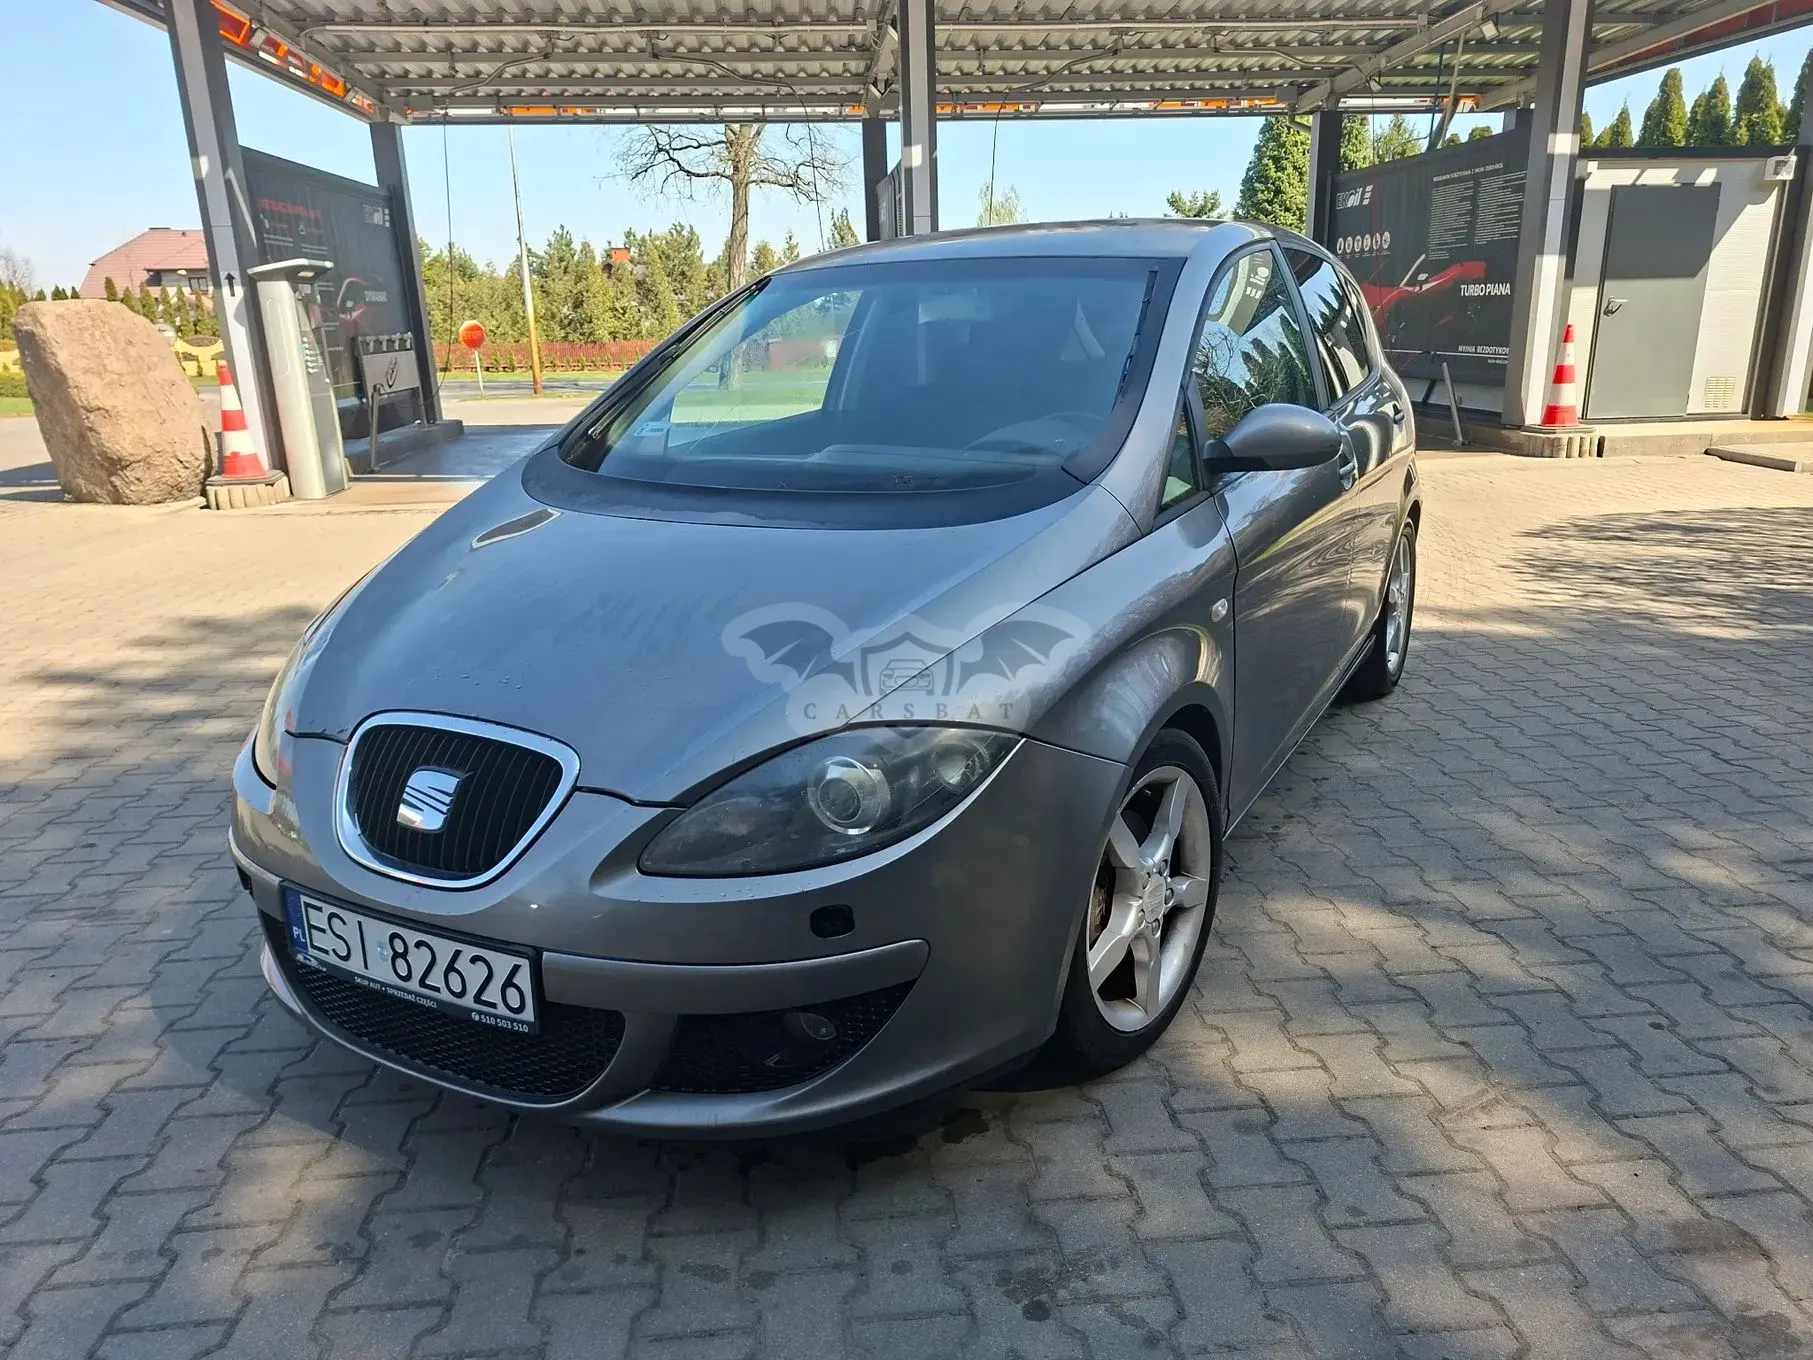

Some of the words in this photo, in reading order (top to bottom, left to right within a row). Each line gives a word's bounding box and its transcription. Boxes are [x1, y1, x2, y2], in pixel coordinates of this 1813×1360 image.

[1460, 284, 1485, 297] TURBO
[1486, 282, 1511, 296] PIANA
[293, 927, 305, 943] PL
[303, 900, 369, 970] ESI
[389, 931, 526, 1015] 82626
[481, 1014, 495, 1025] 510
[497, 1018, 511, 1029] 503
[513, 1022, 529, 1033] 510
